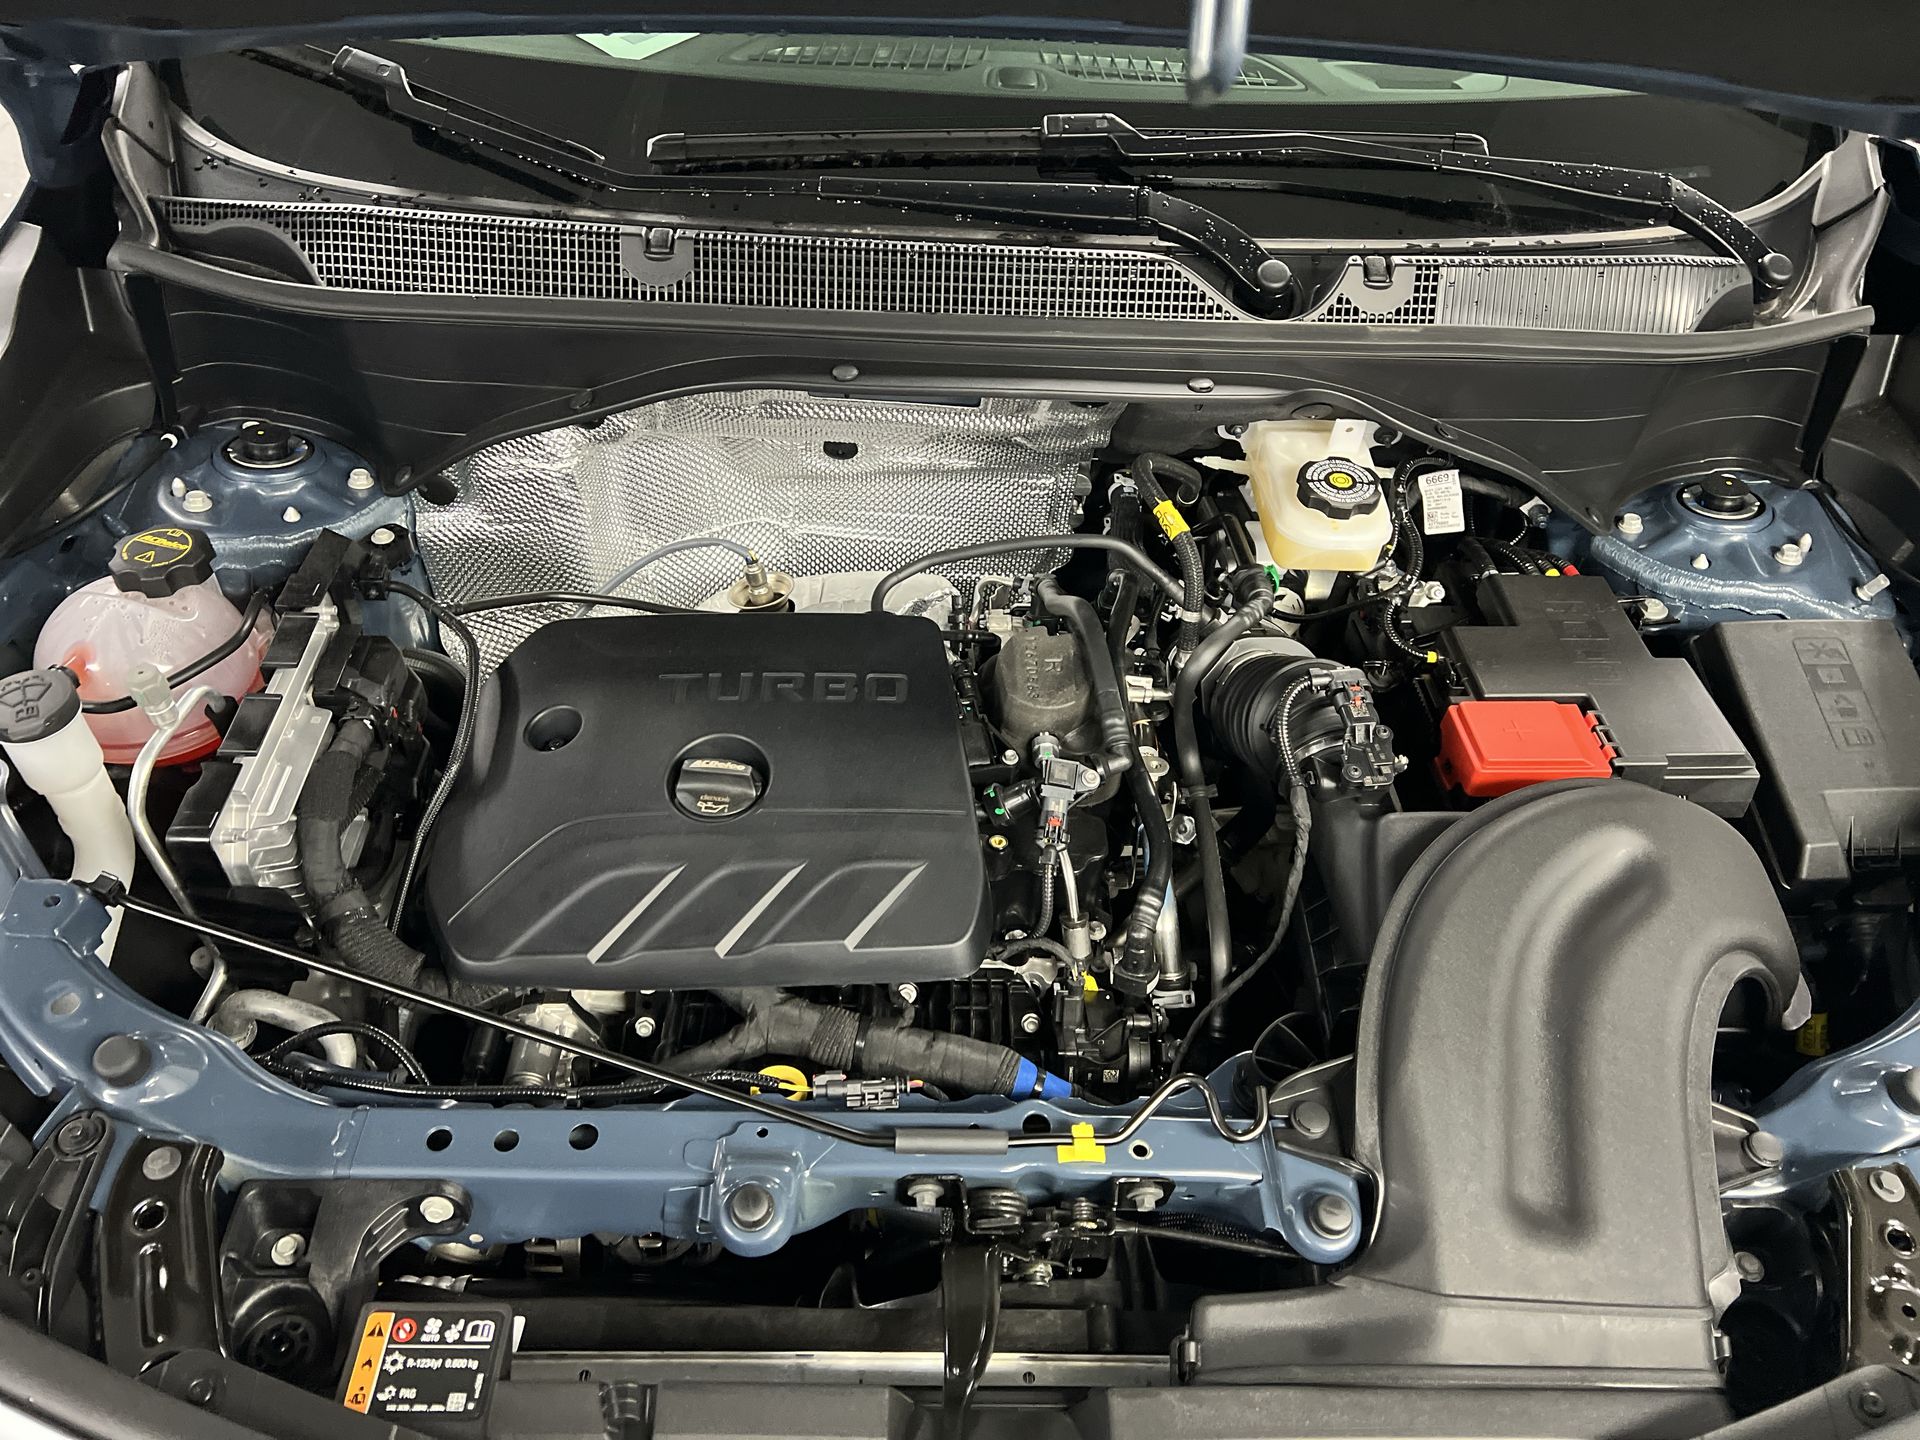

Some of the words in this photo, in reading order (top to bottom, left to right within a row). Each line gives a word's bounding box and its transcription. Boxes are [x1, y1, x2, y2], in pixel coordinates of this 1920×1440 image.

[1425, 473, 1449, 485] 6669
[658, 671, 908, 704] TURBO
[420, 1333, 441, 1343] AUTO
[468, 1358, 479, 1370] kg
[399, 1387, 417, 1399] PAG
